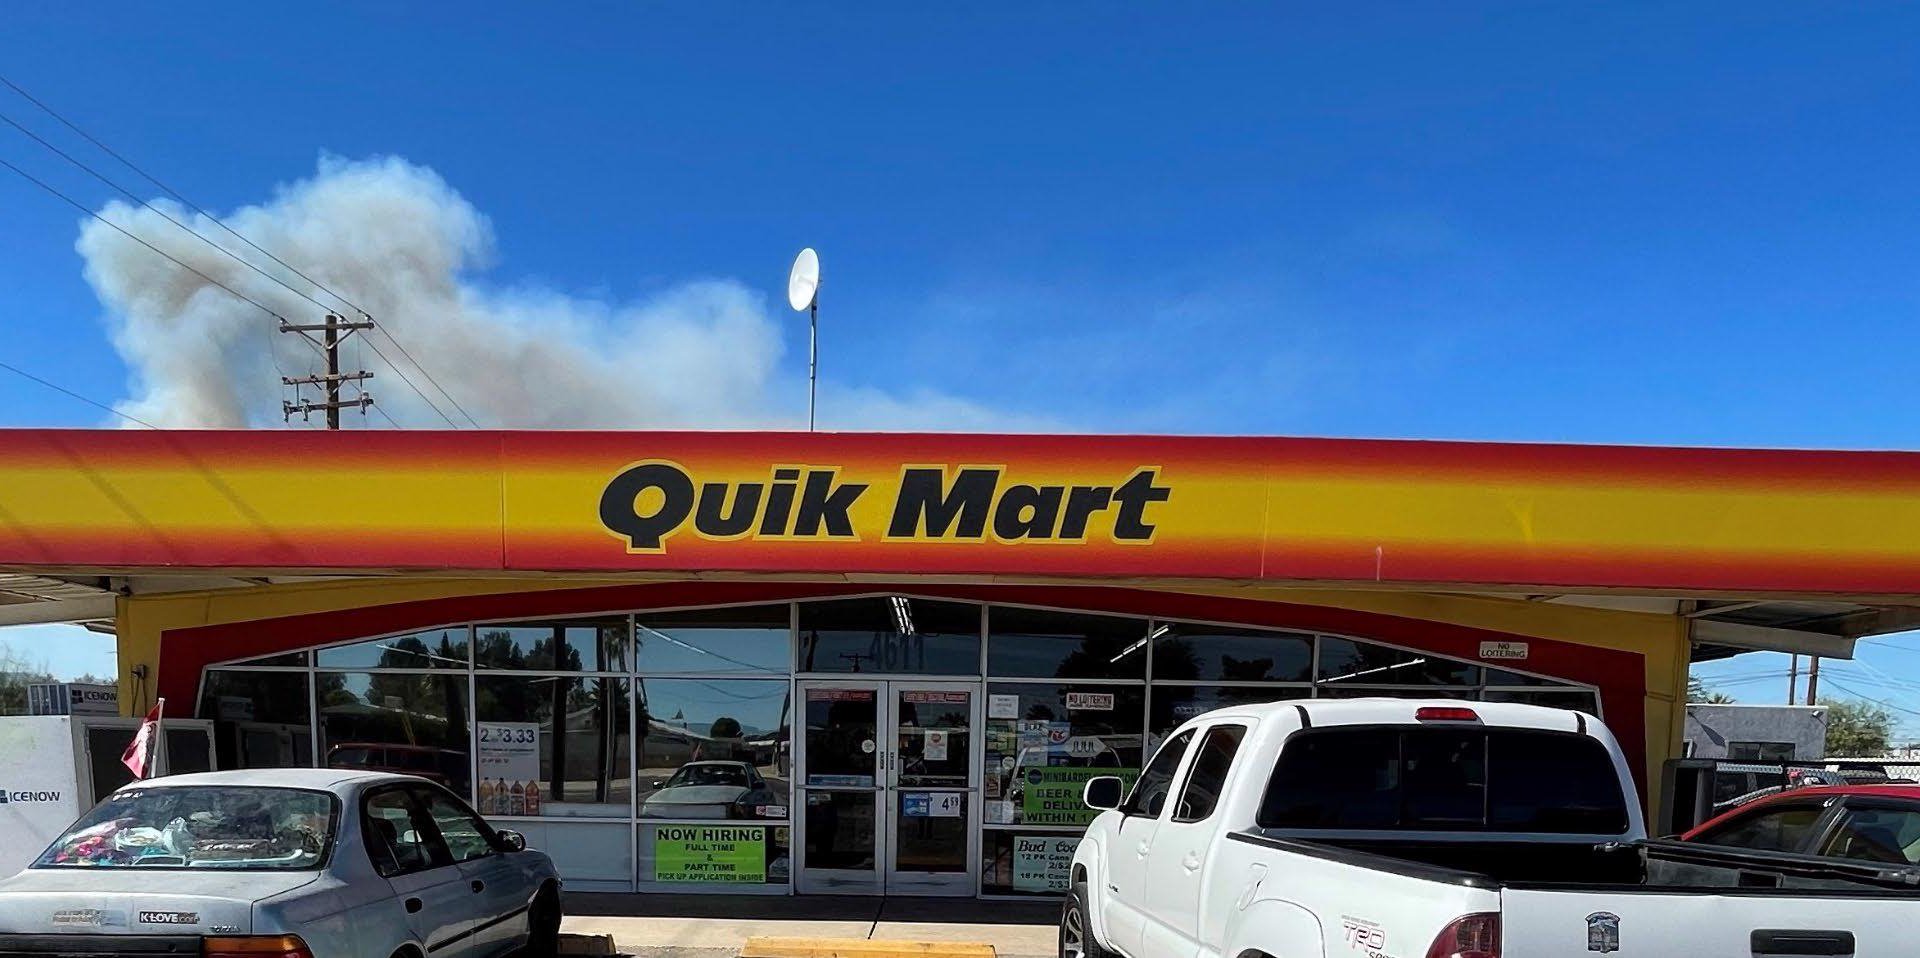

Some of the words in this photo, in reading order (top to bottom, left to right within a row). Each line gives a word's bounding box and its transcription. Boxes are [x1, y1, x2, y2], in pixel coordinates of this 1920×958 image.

[599, 462, 870, 551] Quik
[885, 467, 1172, 542] Mart
[1481, 650, 1525, 658] LOITERING
[84, 691, 117, 701] ICENOW
[480, 728, 489, 742] 2
[497, 728, 535, 743] $3.33
[9, 792, 61, 802] ICENOW
[1036, 789, 1073, 799] BEER
[1026, 812, 1076, 822] WITHIN
[658, 829, 697, 840] NOW
[702, 830, 763, 841] HIRING
[1018, 840, 1046, 852] Bud
[688, 873, 736, 881] APPLICATION
[739, 873, 763, 881] INSIDE
[1343, 920, 1385, 952] TRD
